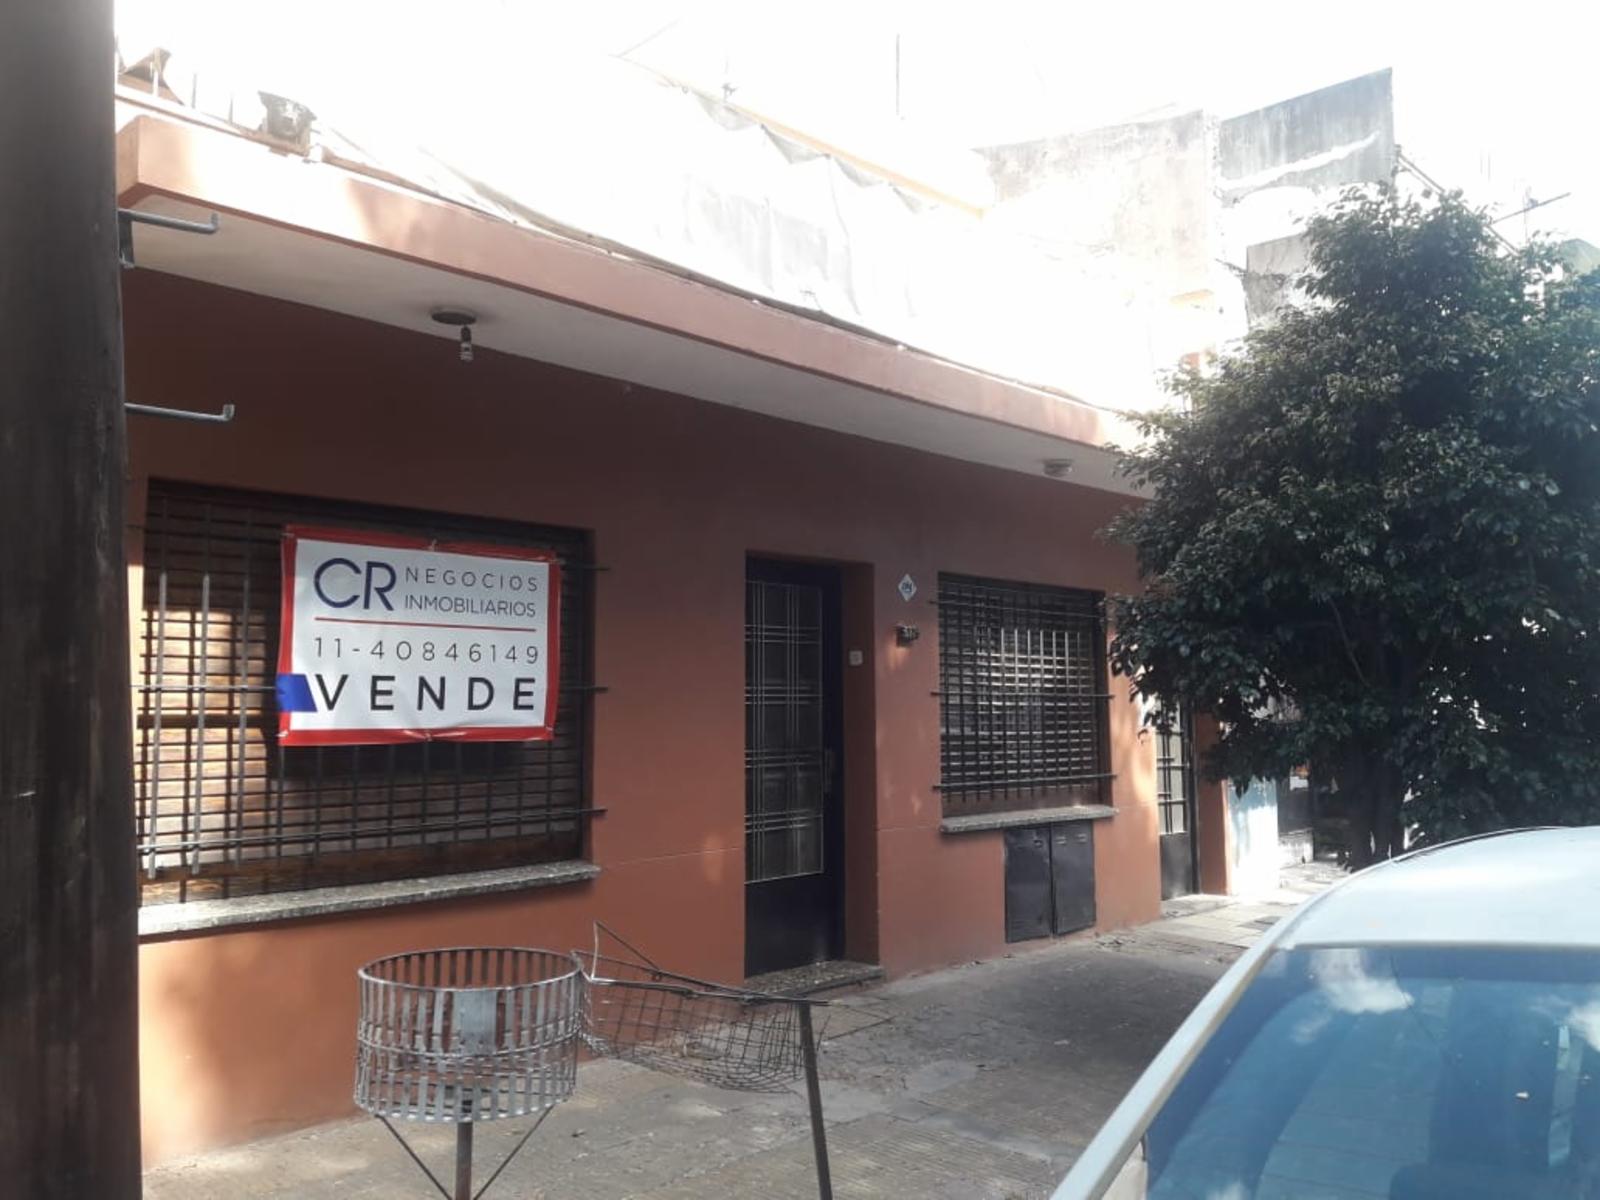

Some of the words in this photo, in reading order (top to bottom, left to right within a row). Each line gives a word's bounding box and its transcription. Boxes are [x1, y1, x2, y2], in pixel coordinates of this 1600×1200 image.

[314, 557, 397, 611] CR
[405, 567, 538, 592] NEGOCIOS
[405, 595, 536, 618] INMOBILIARIOS
[314, 637, 539, 664] 11-40846149
[314, 674, 536, 711] VENDE
